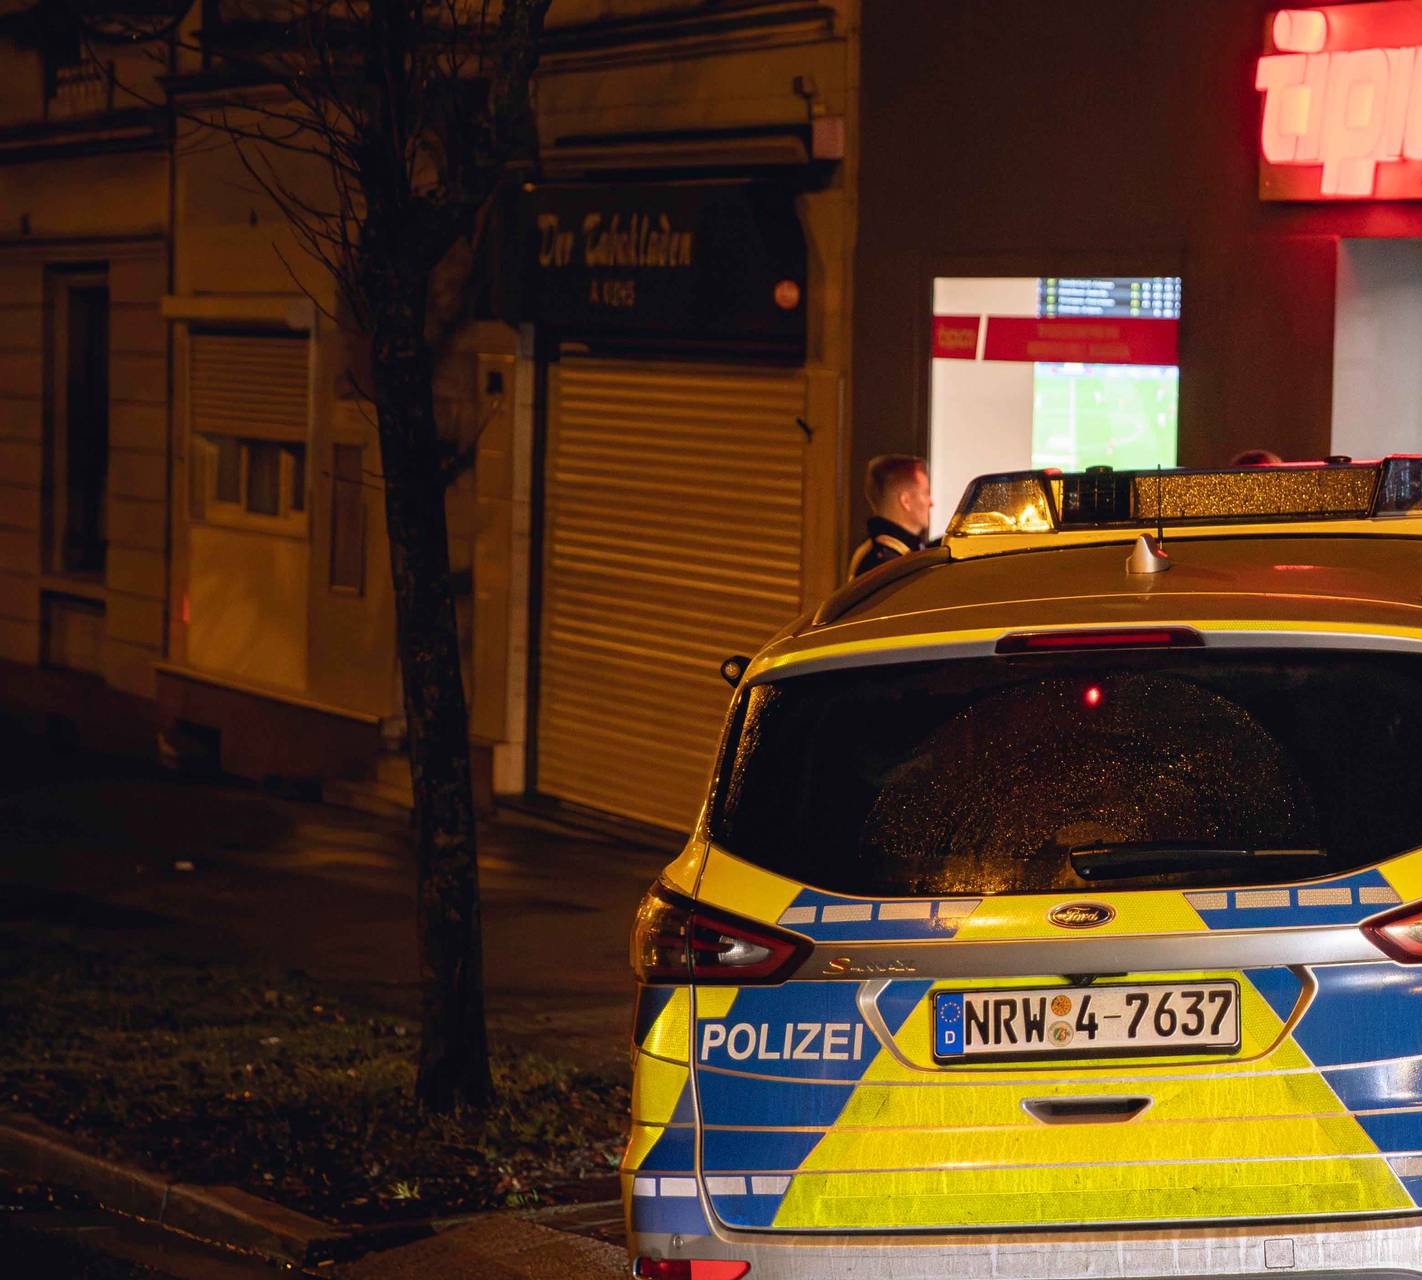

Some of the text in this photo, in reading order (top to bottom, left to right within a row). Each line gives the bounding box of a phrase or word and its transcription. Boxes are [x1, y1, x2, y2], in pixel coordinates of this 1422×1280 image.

[944, 1030, 956, 1044] D
[964, 989, 1233, 1046] NRW 4-7637
[701, 1022, 863, 1061] POLIZEI
